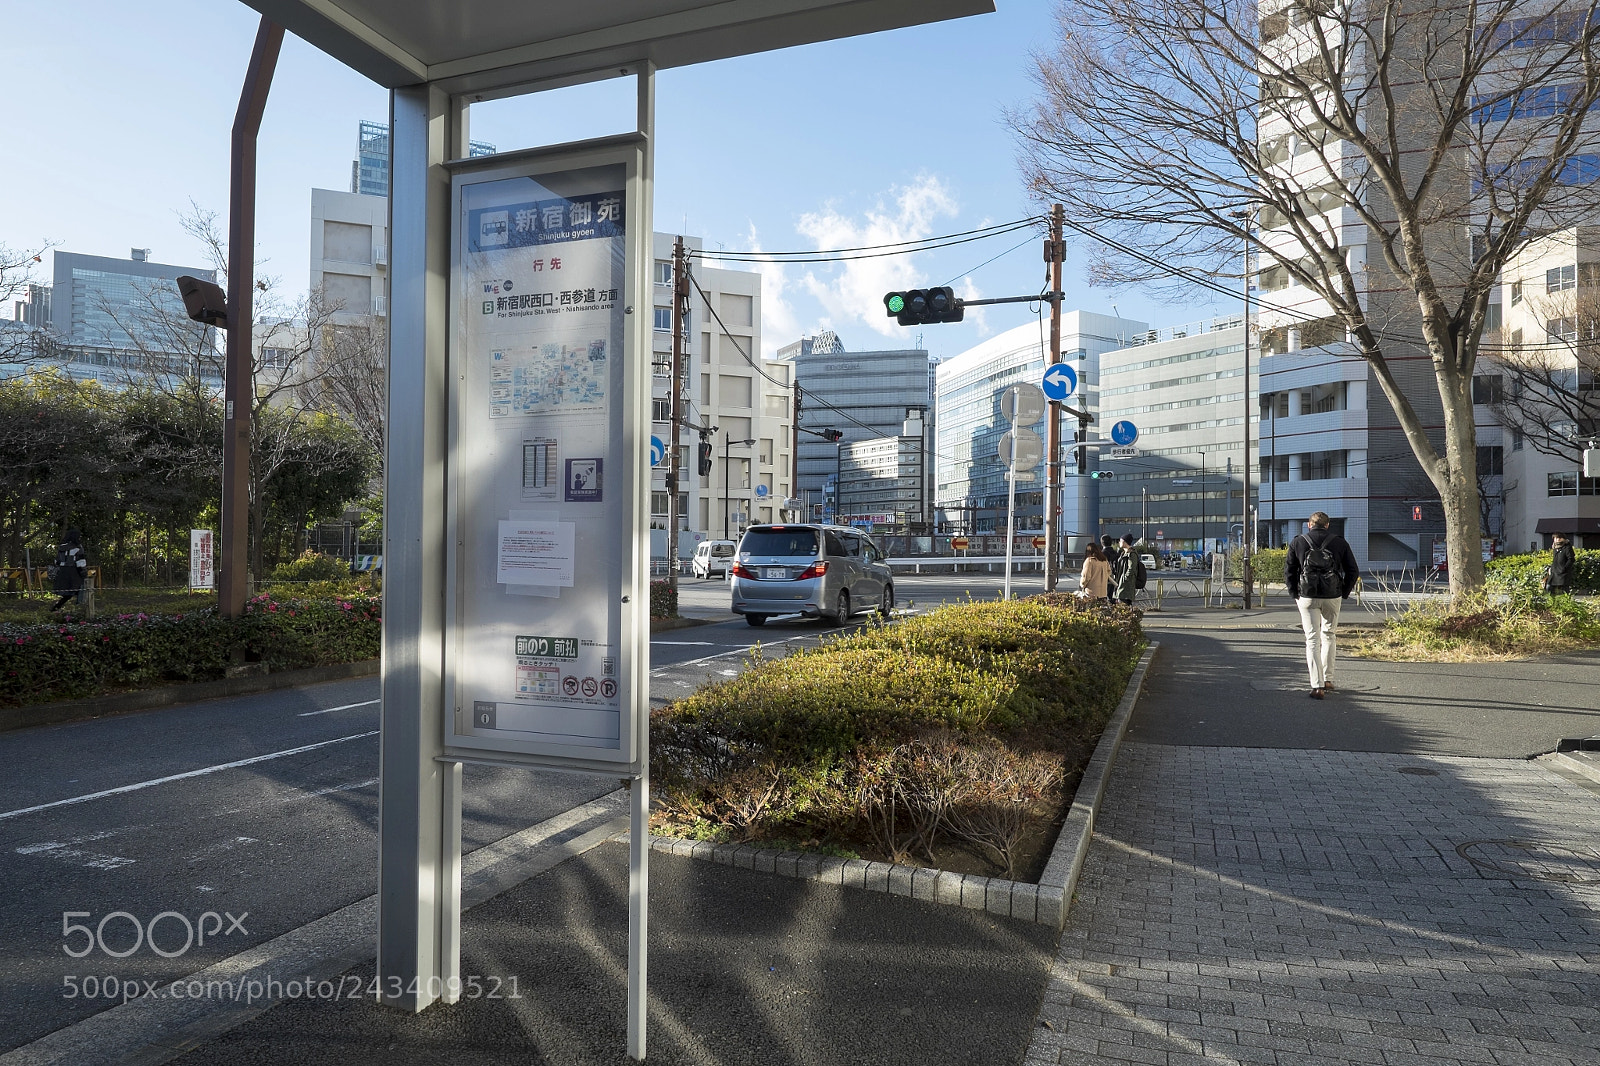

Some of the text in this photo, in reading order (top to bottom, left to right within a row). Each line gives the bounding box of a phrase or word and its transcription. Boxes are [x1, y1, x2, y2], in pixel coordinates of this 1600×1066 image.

[515, 197, 621, 233] 新宿御苑
[538, 228, 595, 242] Shinjuku gyoen
[533, 257, 562, 272] 行先
[598, 289, 619, 302] 方面
[484, 302, 493, 314] B
[508, 309, 533, 319] Shinjuku
[566, 304, 599, 313] Nishisando
[517, 638, 576, 657] 前のり 前払
